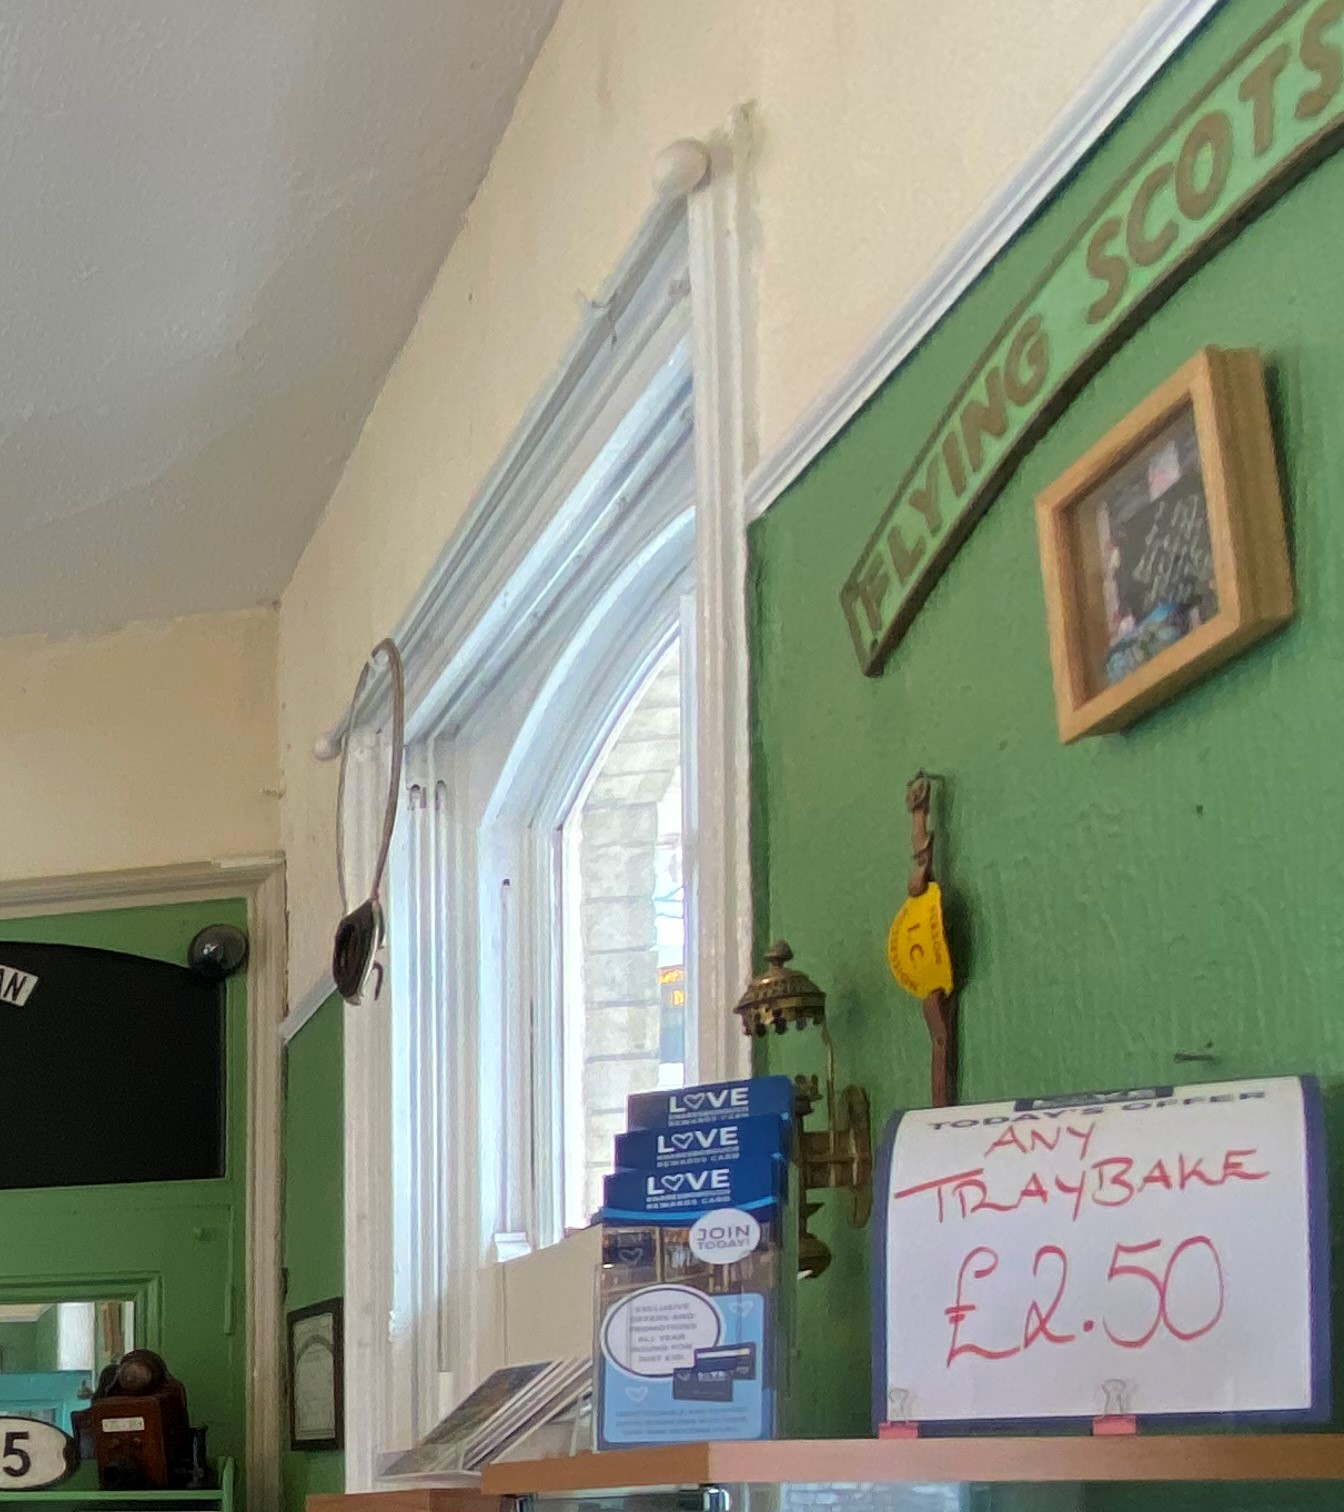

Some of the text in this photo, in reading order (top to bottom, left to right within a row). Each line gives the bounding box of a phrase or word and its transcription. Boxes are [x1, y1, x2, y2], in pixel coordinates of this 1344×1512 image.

[856, 0, 1344, 634] FLYING SCOTS
[928, 1105, 1104, 1131] TODAY'S
[1121, 1091, 1267, 1111] OFFER
[984, 1122, 1095, 1161] ANY
[894, 1149, 1269, 1223] TRAYBAKE
[697, 1224, 751, 1242] JOIN
[698, 1238, 750, 1251] TODAY!
[945, 1235, 1224, 1368] £2.50
